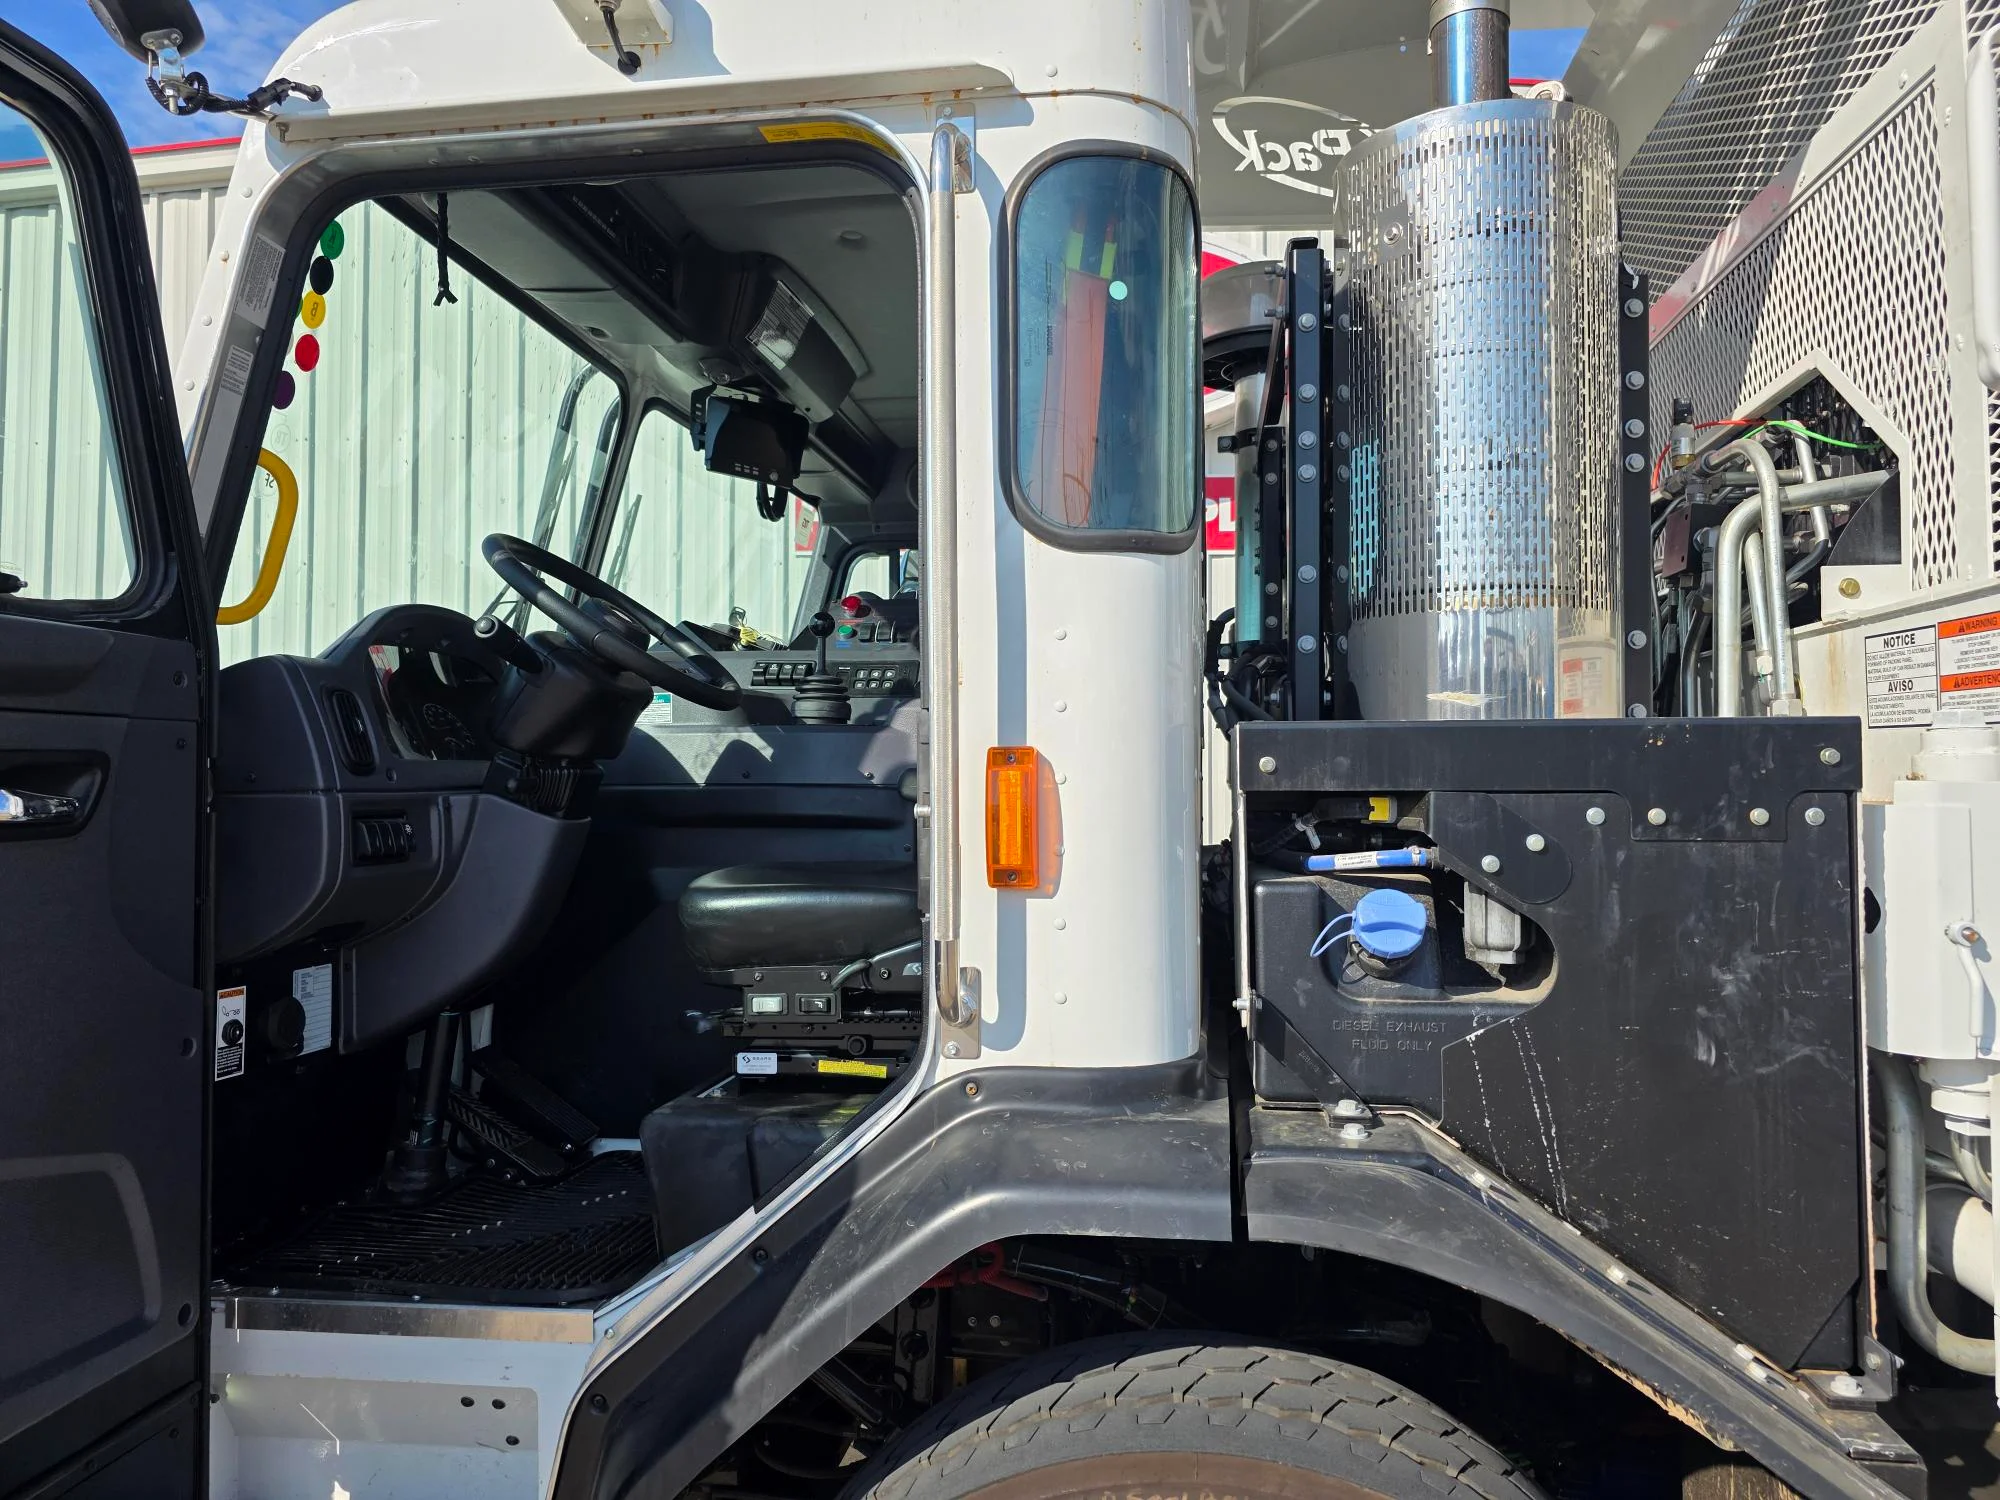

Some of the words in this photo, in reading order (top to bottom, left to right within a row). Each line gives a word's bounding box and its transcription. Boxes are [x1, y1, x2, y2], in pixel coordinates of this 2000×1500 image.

[1965, 616, 1998, 630] WARNING
[1884, 633, 1916, 648] NOTICE
[1888, 680, 1914, 692] AVISO
[1332, 1020, 1379, 1032] DIESEL
[1386, 1021, 1446, 1033] EXHAUST
[1352, 1040, 1388, 1050] FLUID
[1396, 1040, 1432, 1052] ONLY
